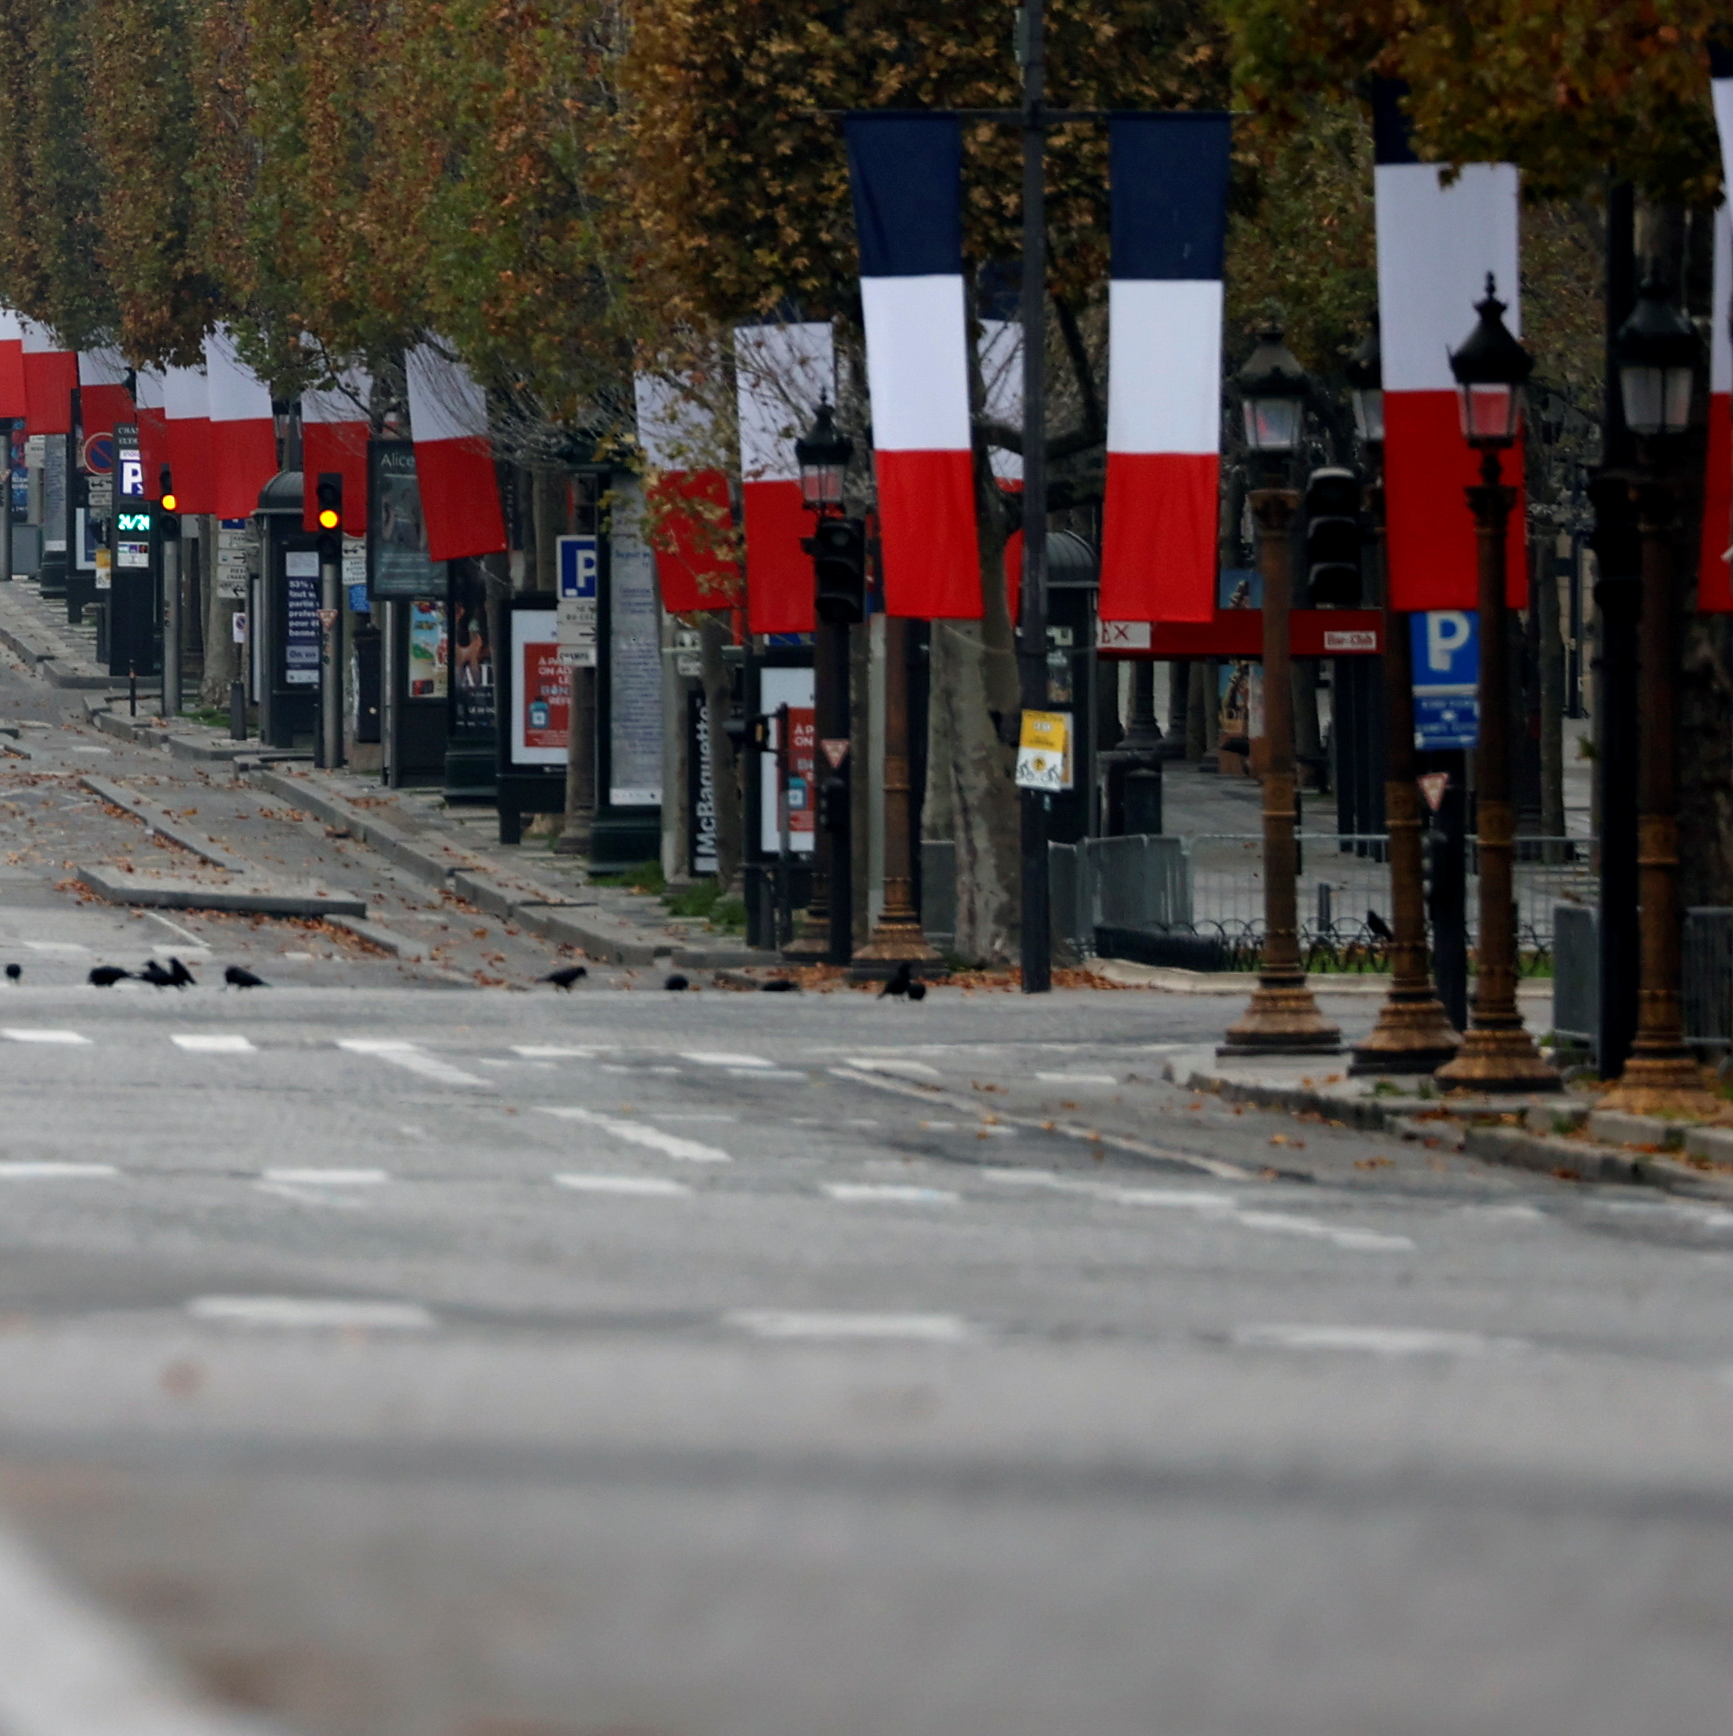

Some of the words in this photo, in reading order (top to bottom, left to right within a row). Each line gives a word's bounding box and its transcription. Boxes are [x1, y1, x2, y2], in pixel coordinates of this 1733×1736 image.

[122, 462, 143, 494] P
[118, 514, 150, 531] 24/24
[576, 549, 597, 588] P
[1427, 610, 1470, 672] P
[556, 666, 571, 675] AD
